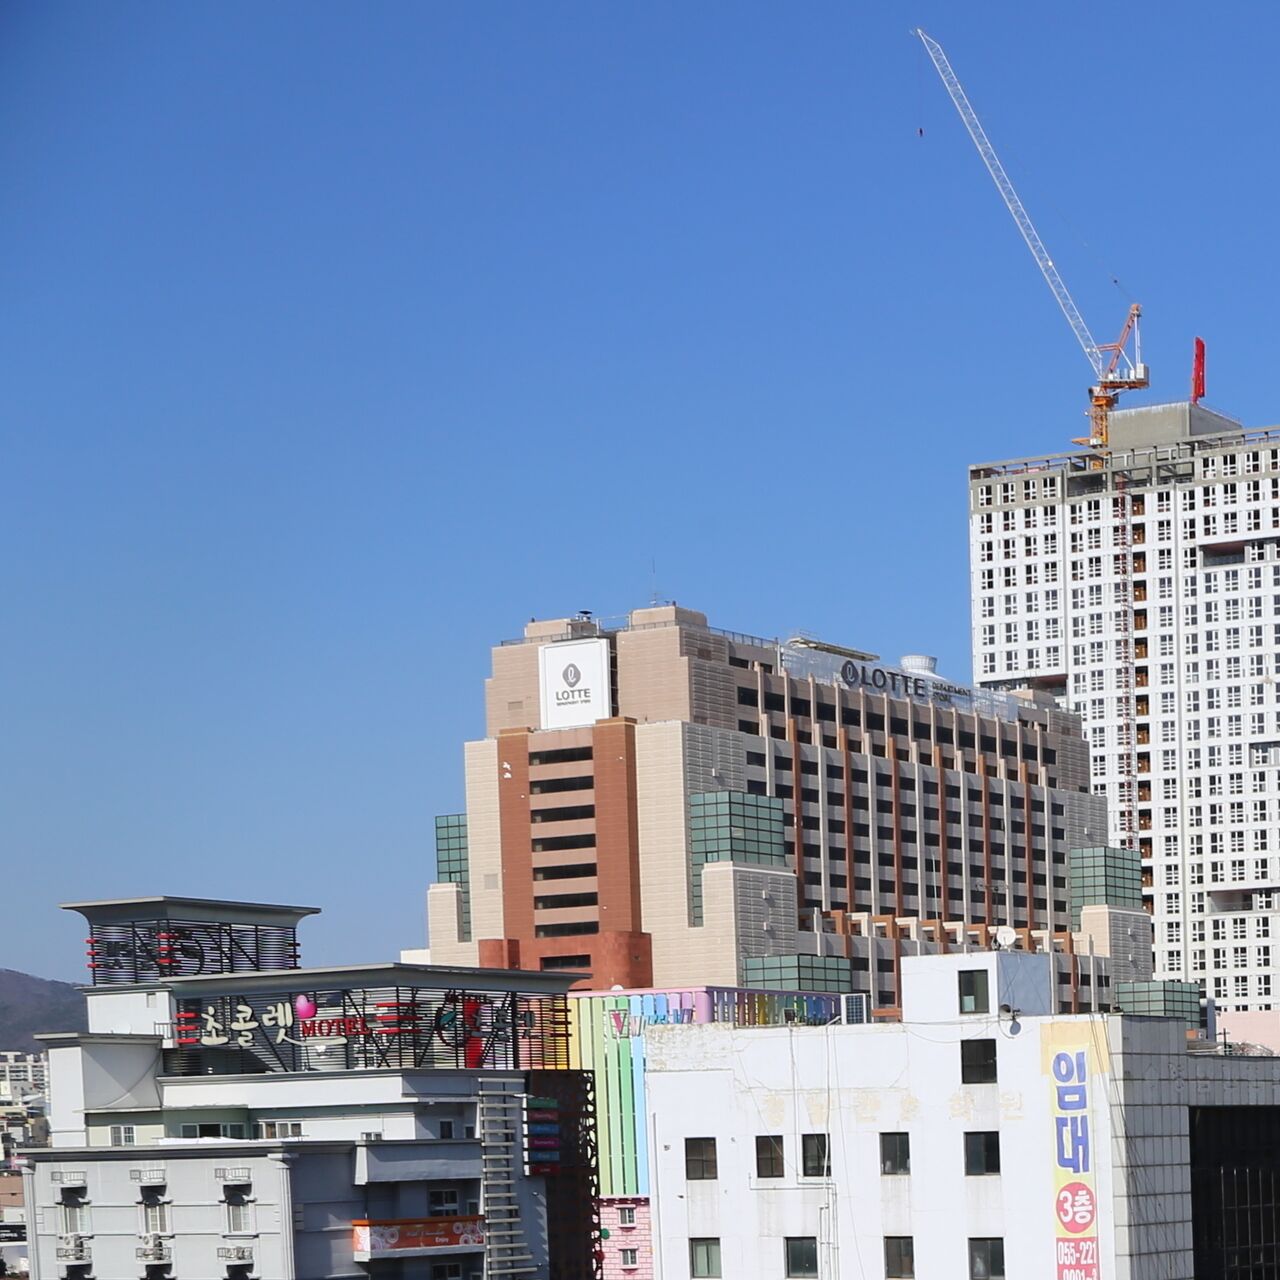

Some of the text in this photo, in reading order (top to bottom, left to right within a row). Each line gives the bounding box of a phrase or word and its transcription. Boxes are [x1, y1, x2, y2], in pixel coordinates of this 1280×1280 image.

[556, 688, 591, 701] LOTTE
[860, 666, 925, 697] LOTTE
[201, 1003, 347, 1046] 초콜렛
[300, 1018, 372, 1038] MOTEL
[1053, 1051, 1090, 1174] 임대
[1059, 1189, 1093, 1225] 3층
[1058, 1240, 1097, 1266] 055-221
